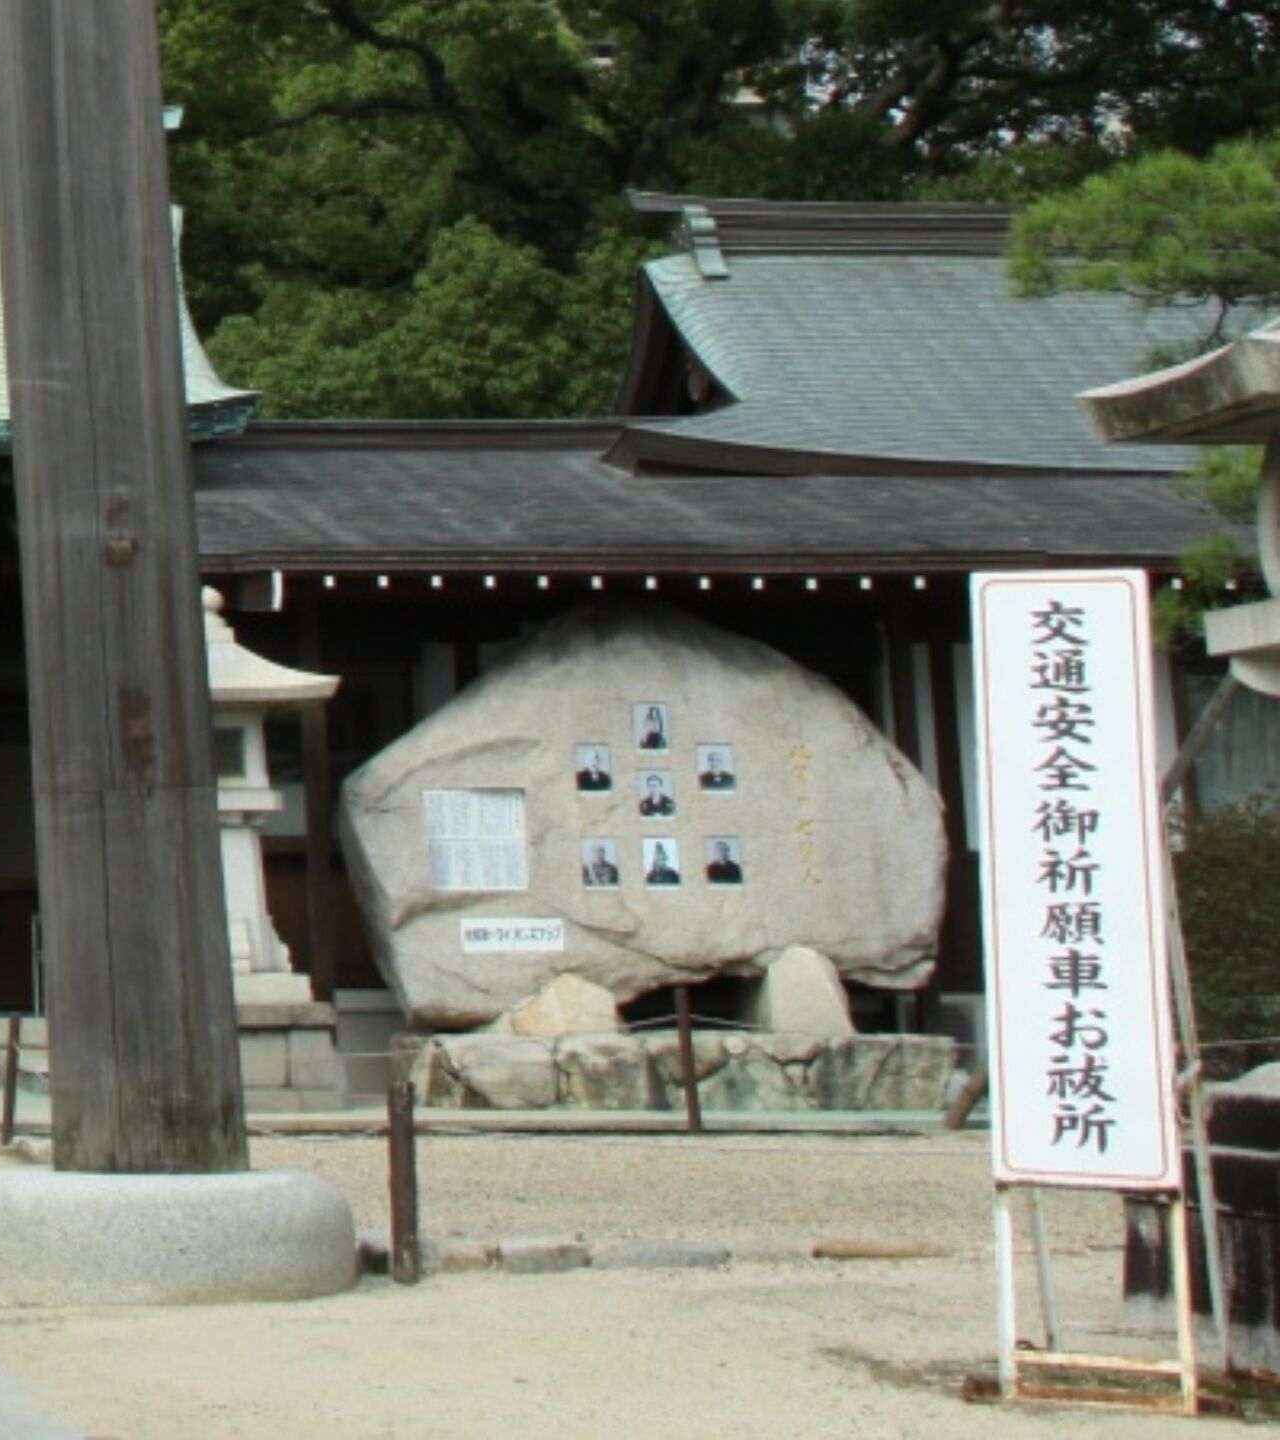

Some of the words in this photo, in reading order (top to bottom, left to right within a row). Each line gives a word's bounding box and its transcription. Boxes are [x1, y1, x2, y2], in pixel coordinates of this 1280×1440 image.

[1029, 600, 1117, 1153] 交通安全御祈願車お祓所
